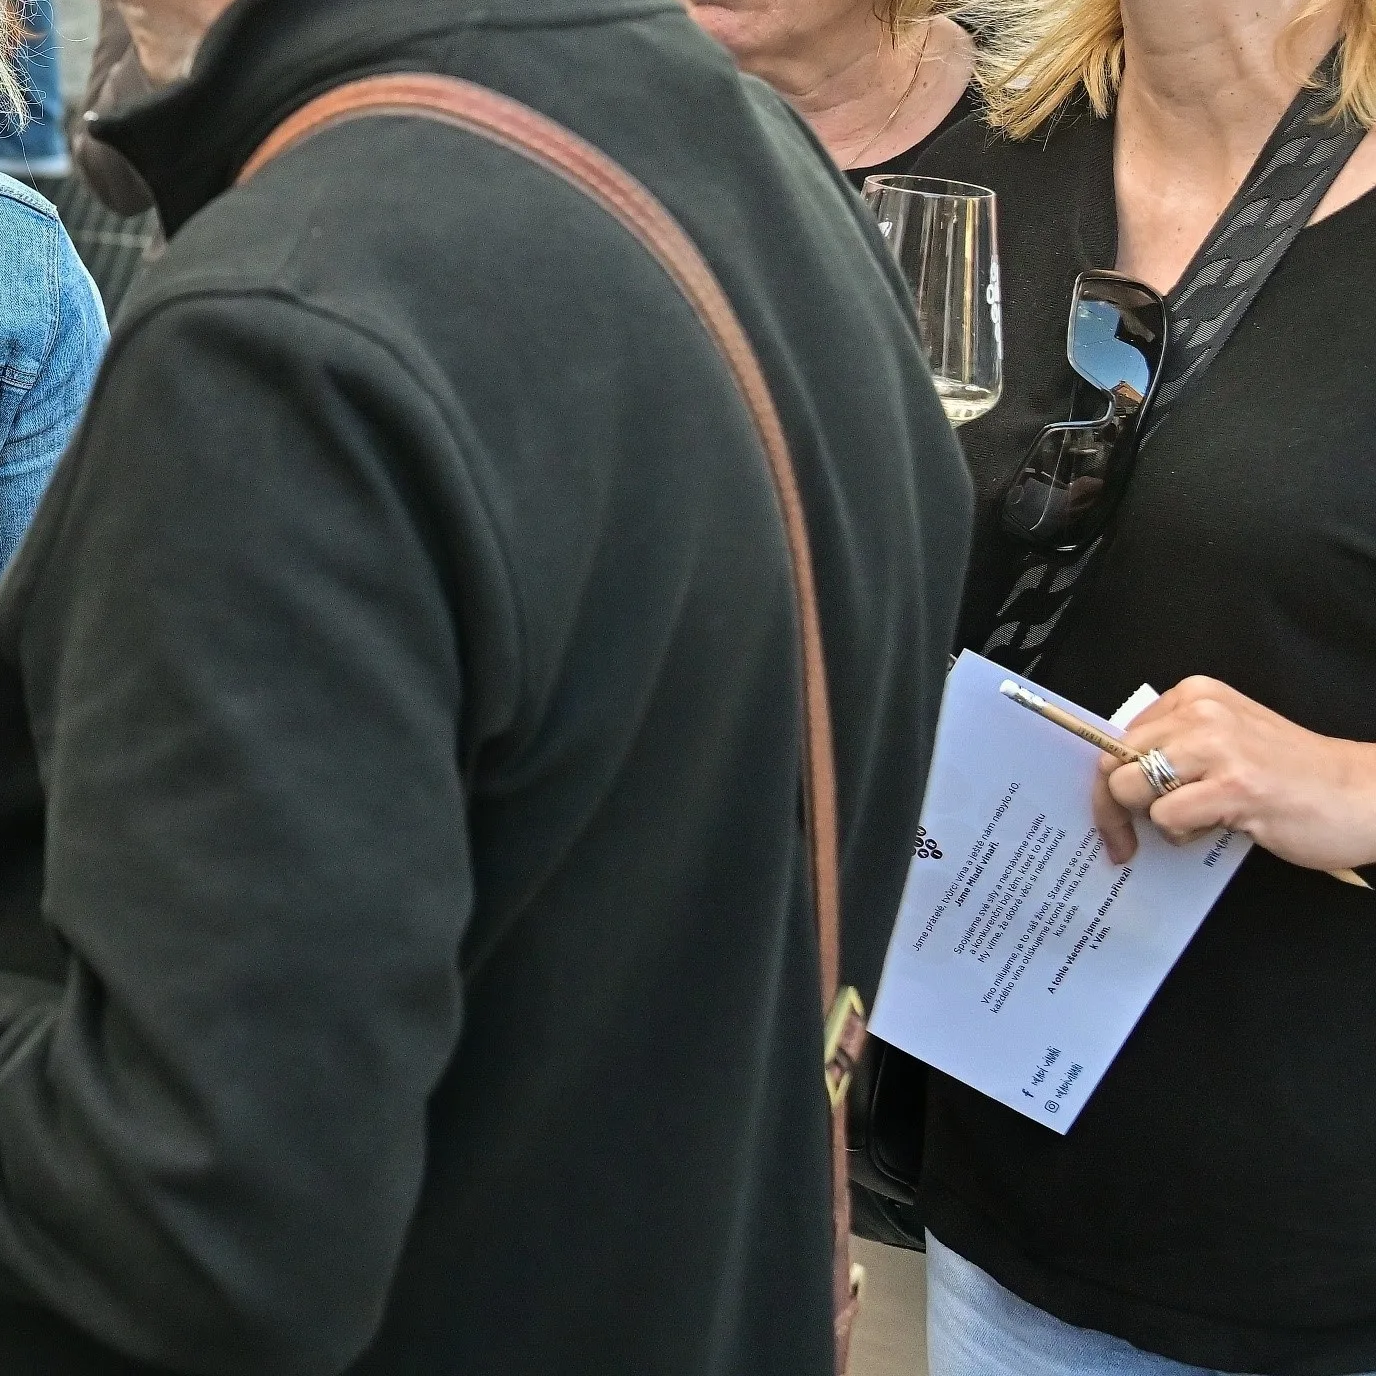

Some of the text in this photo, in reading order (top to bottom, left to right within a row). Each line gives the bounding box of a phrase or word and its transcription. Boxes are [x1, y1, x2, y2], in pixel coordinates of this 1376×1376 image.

[1035, 824, 1054, 844] baví.
[1030, 843, 1042, 854] to
[1074, 849, 1082, 857] o
[911, 930, 929, 952] Jsme
[924, 904, 947, 933] přátelé,
[940, 881, 960, 904] tvůrci
[954, 865, 970, 882] vína
[966, 839, 985, 861] ještě
[981, 821, 996, 841] nám
[991, 794, 1012, 823] nebylo
[1007, 781, 1021, 795] 40.
[1016, 853, 1036, 875] které
[1067, 856, 1078, 868] se
[952, 812, 1046, 955] Spojujeme své síly a necháváme rivalitu
[953, 841, 1000, 908] Jsme Mladí vinaři.
[1006, 875, 1024, 892] těm,
[1046, 867, 1072, 900] Staráme
[976, 827, 1067, 963] My víme, že dobré věci si nekonkurují.
[997, 891, 1014, 906] boj
[1033, 901, 1052, 921] život.
[970, 903, 1004, 949] konkurenční
[1026, 919, 1039, 935] náš
[1046, 865, 1133, 995] A tohle všechno jsme dnes přivezli
[1051, 905, 1080, 938] kus sebe.
[988, 981, 1015, 1014] každého
[1010, 964, 1026, 981] vína
[1021, 925, 1050, 965] otiskujeme
[1044, 901, 1066, 926] kromě
[1061, 879, 1082, 902] místa,
[1074, 862, 1090, 879] kde
[1018, 933, 1030, 943] to
[1092, 925, 1111, 943] Vám.
[1013, 942, 1024, 953] je
[993, 951, 1021, 987] milujeme,
[979, 986, 997, 1004] Víno
